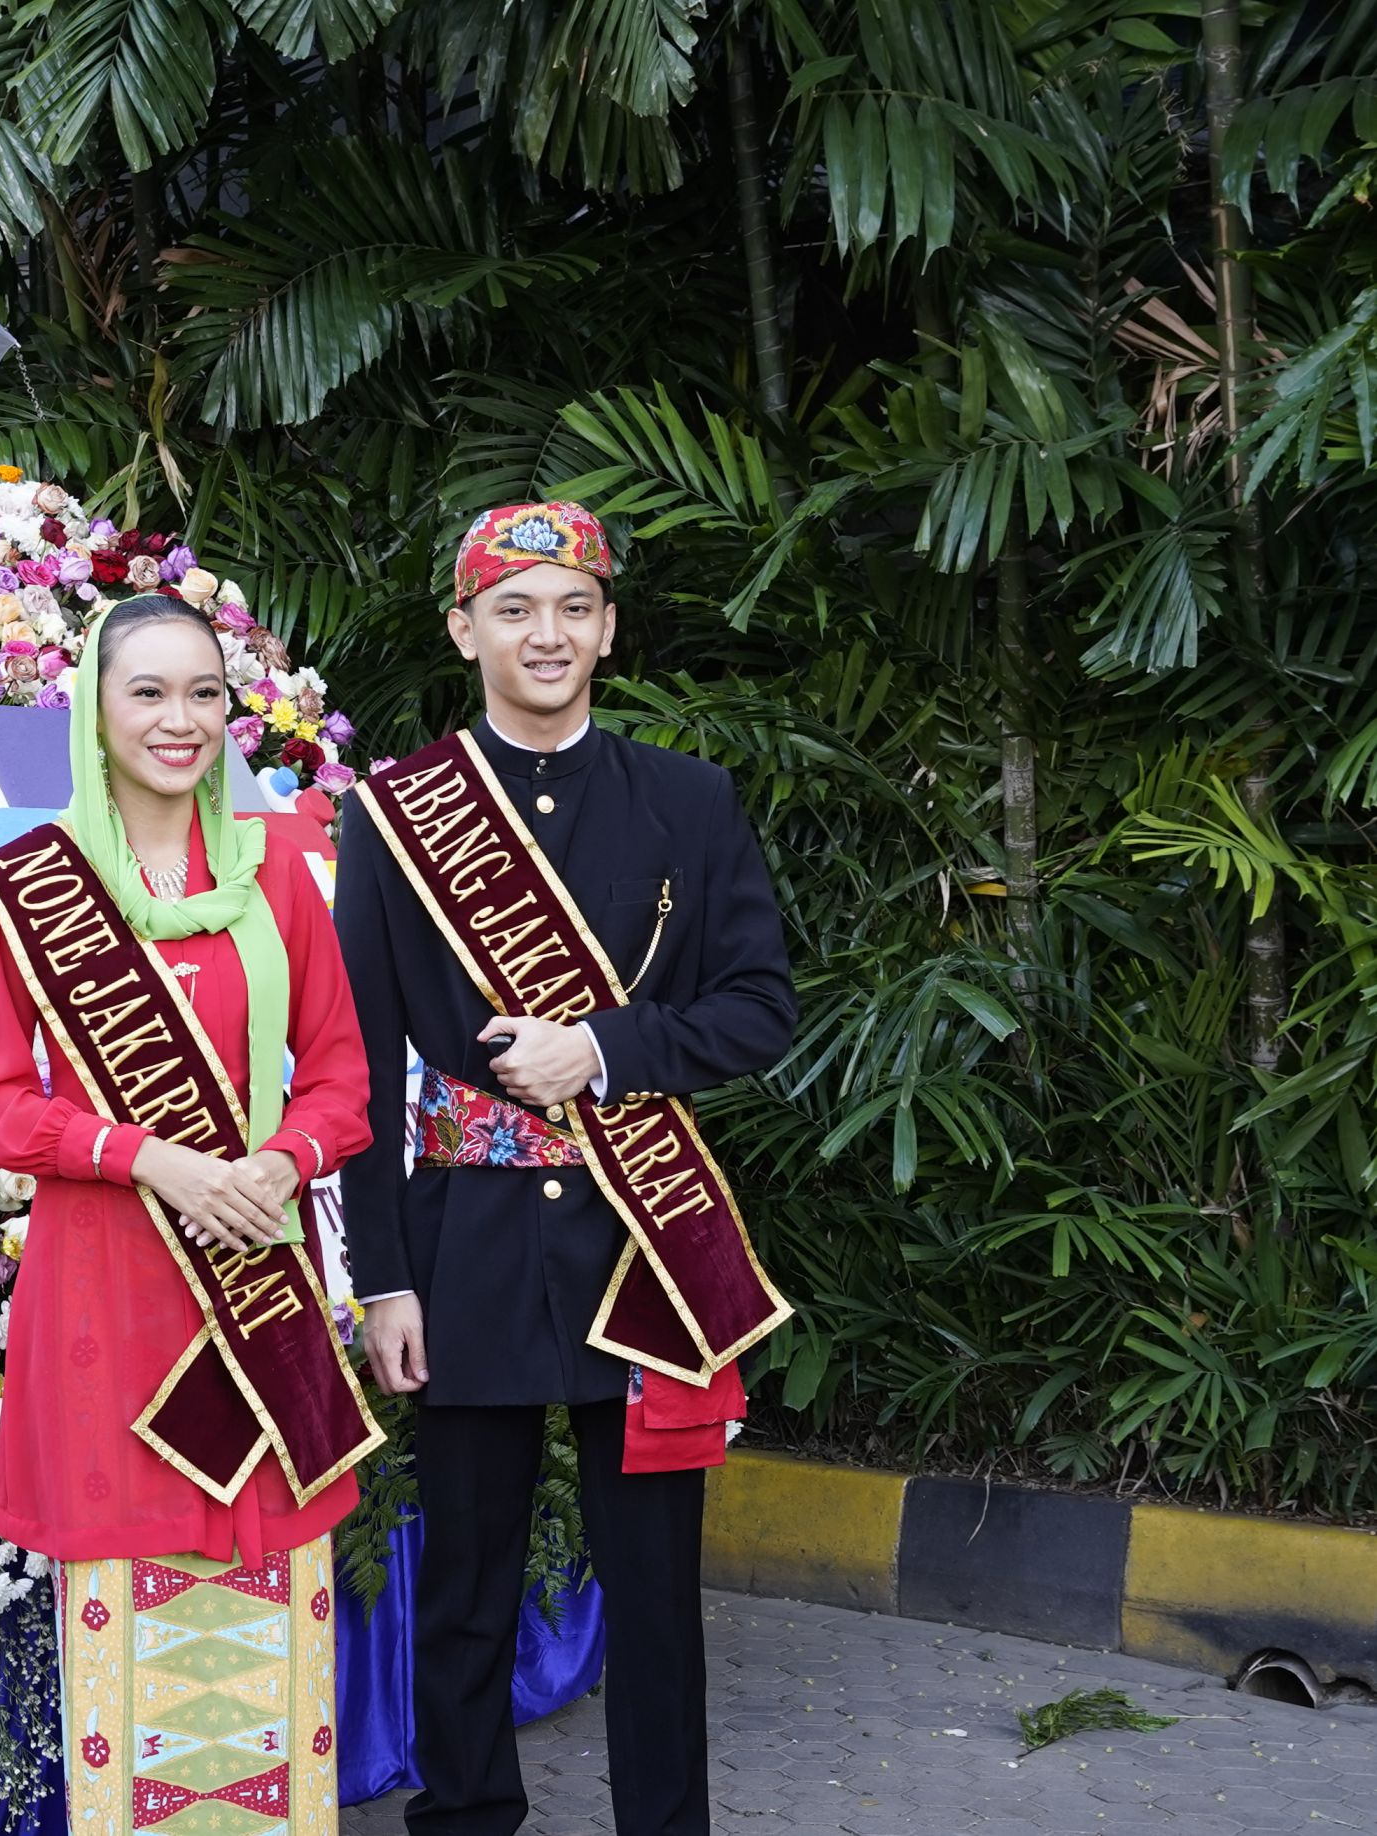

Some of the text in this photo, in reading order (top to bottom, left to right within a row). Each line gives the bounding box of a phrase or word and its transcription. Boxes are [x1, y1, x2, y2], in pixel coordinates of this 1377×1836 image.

[387, 759, 516, 902] ABANG
[470, 890, 596, 1024] JAKAR
[70, 968, 227, 1158] JAKART
[205, 1246, 304, 1340] RAT
